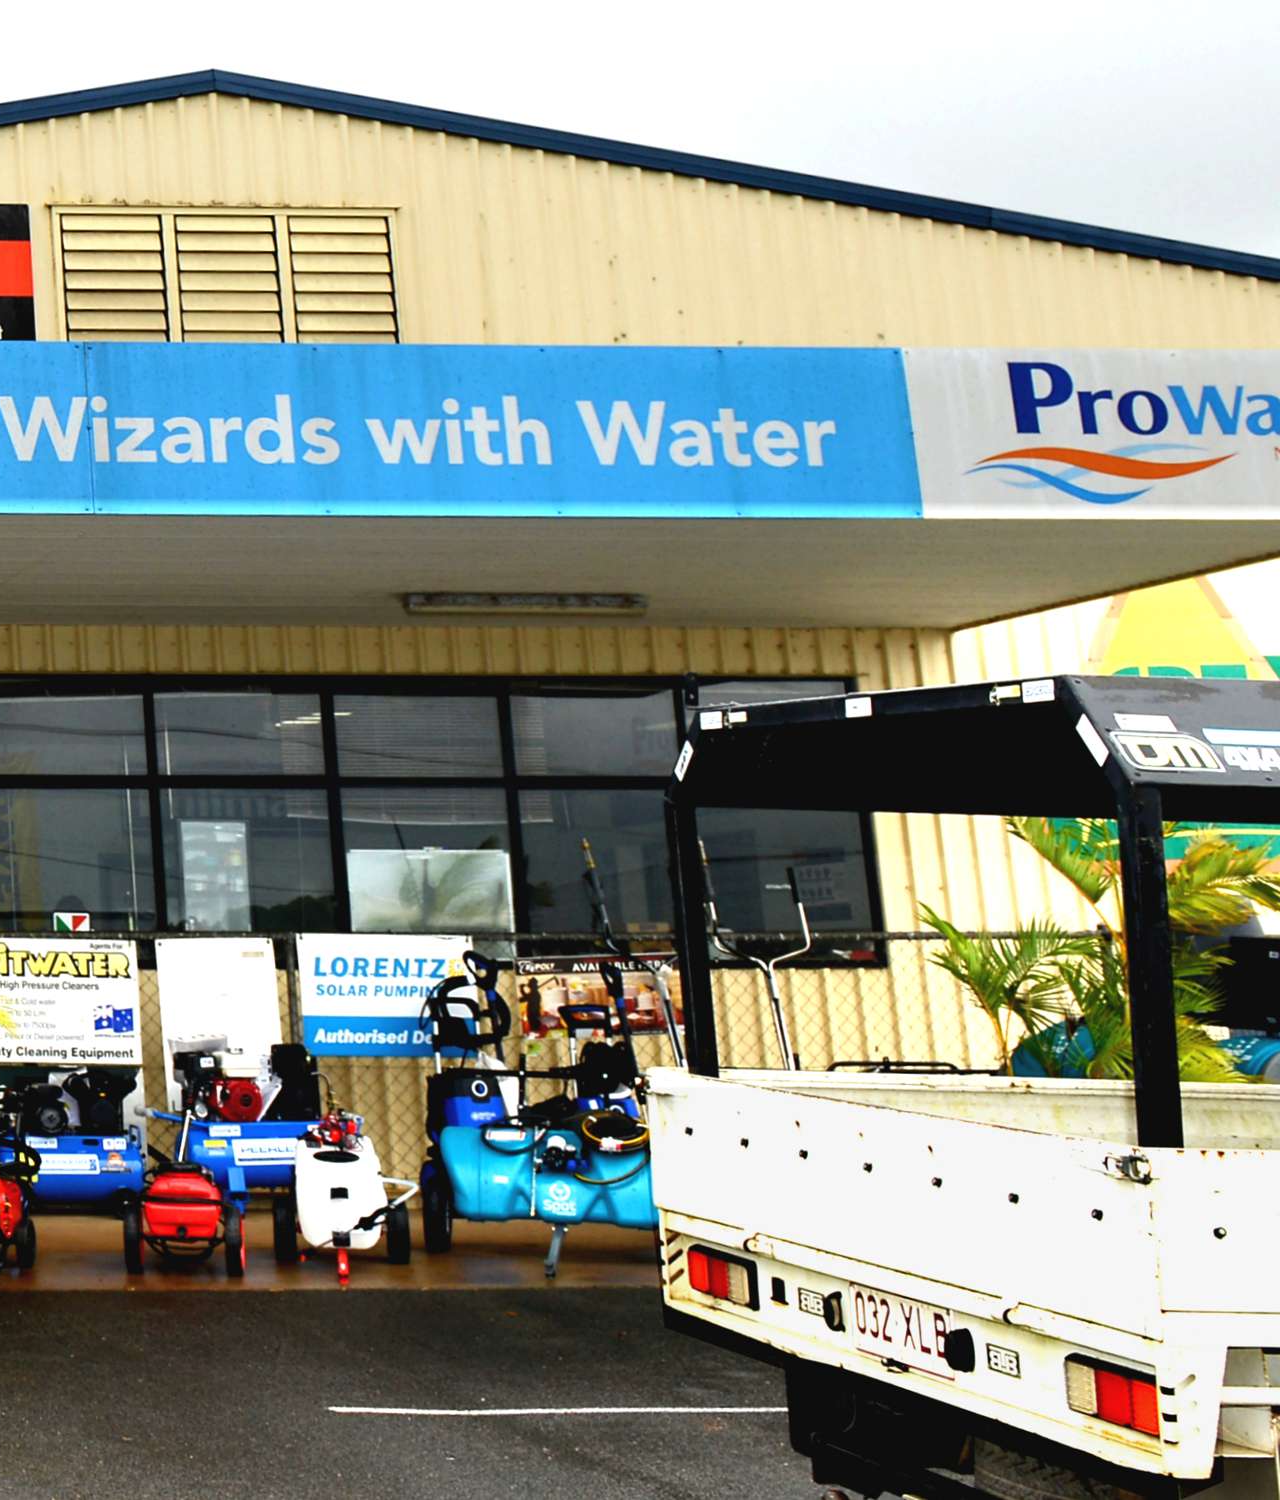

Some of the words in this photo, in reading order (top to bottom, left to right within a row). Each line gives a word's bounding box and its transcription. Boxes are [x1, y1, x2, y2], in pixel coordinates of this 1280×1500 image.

[365, 395, 551, 466] with
[576, 400, 836, 468] Water
[314, 957, 446, 979] LORENTZ
[0, 981, 19, 991] High
[22, 981, 60, 990] Pressure
[62, 982, 100, 991] Cleaners
[316, 984, 368, 997] SOLAR
[374, 986, 435, 998] PUMPIN
[314, 1028, 408, 1044] Authorised
[16, 1046, 68, 1059] Cleaning
[71, 1047, 134, 1060] Equipment
[855, 1291, 893, 1343] 032
